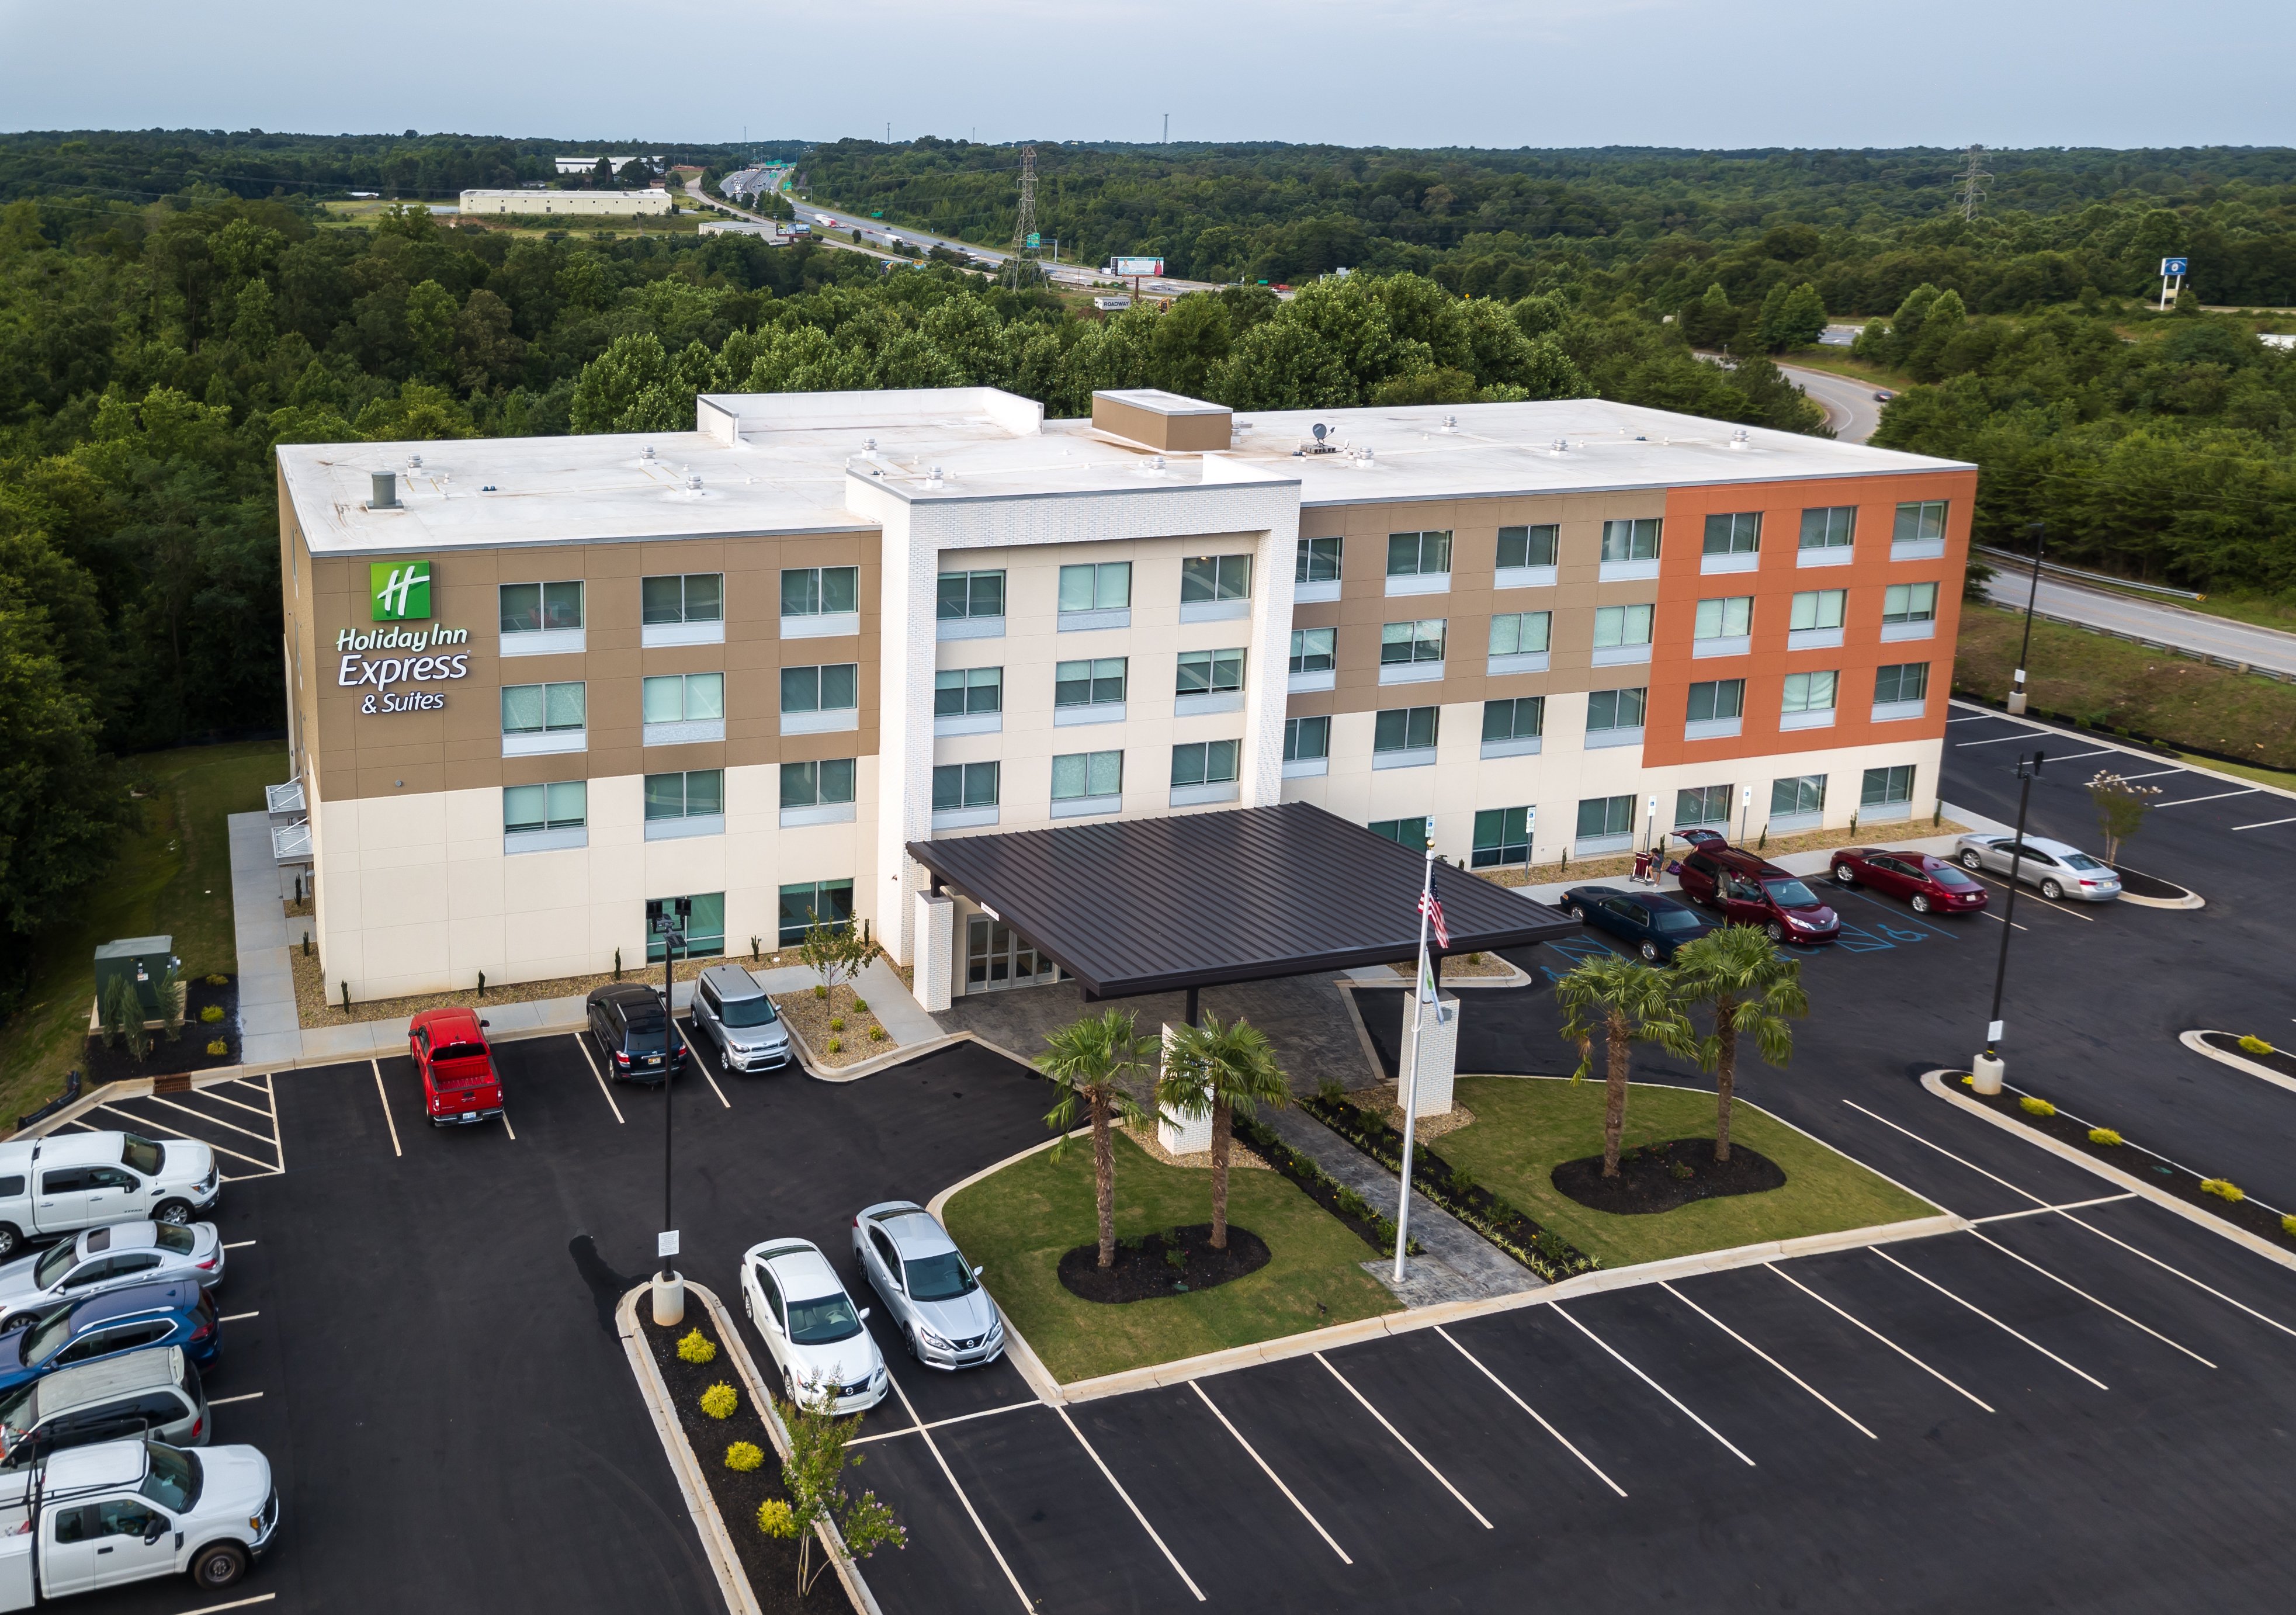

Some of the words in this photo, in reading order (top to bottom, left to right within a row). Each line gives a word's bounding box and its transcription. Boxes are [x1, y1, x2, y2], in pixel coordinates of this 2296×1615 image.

[335, 626, 428, 652] Holiday
[431, 623, 467, 646] Inn
[338, 654, 468, 692] Express
[361, 694, 377, 714] &
[381, 692, 444, 712] Suites
